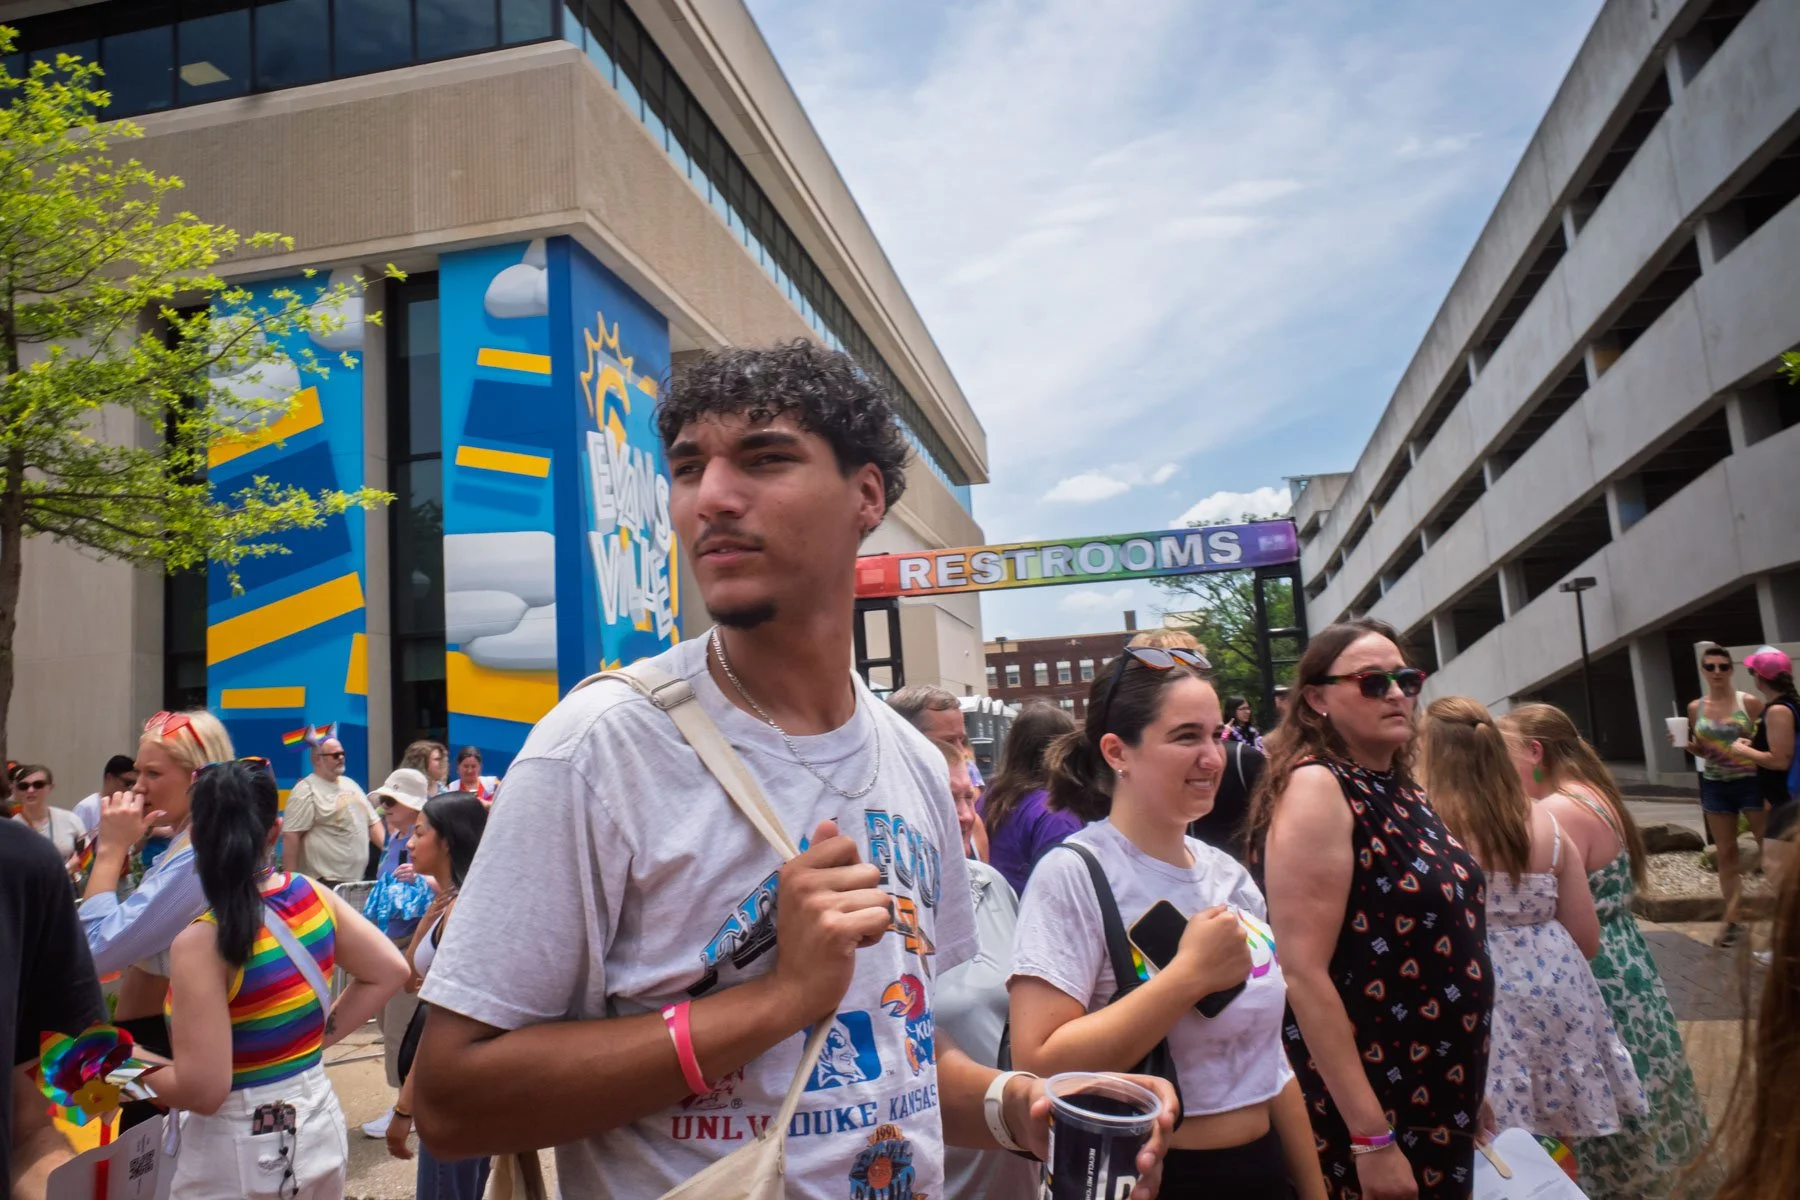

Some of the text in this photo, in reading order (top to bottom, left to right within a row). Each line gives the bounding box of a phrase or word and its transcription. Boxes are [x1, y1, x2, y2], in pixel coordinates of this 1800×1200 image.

[586, 425, 672, 551] EVANS
[589, 531, 673, 641] VILLE
[899, 530, 1242, 590] RESTROOMS
[672, 1083, 937, 1140] UNLV DUKE KANSAS
[1088, 1148, 1097, 1175] RECYCLE
